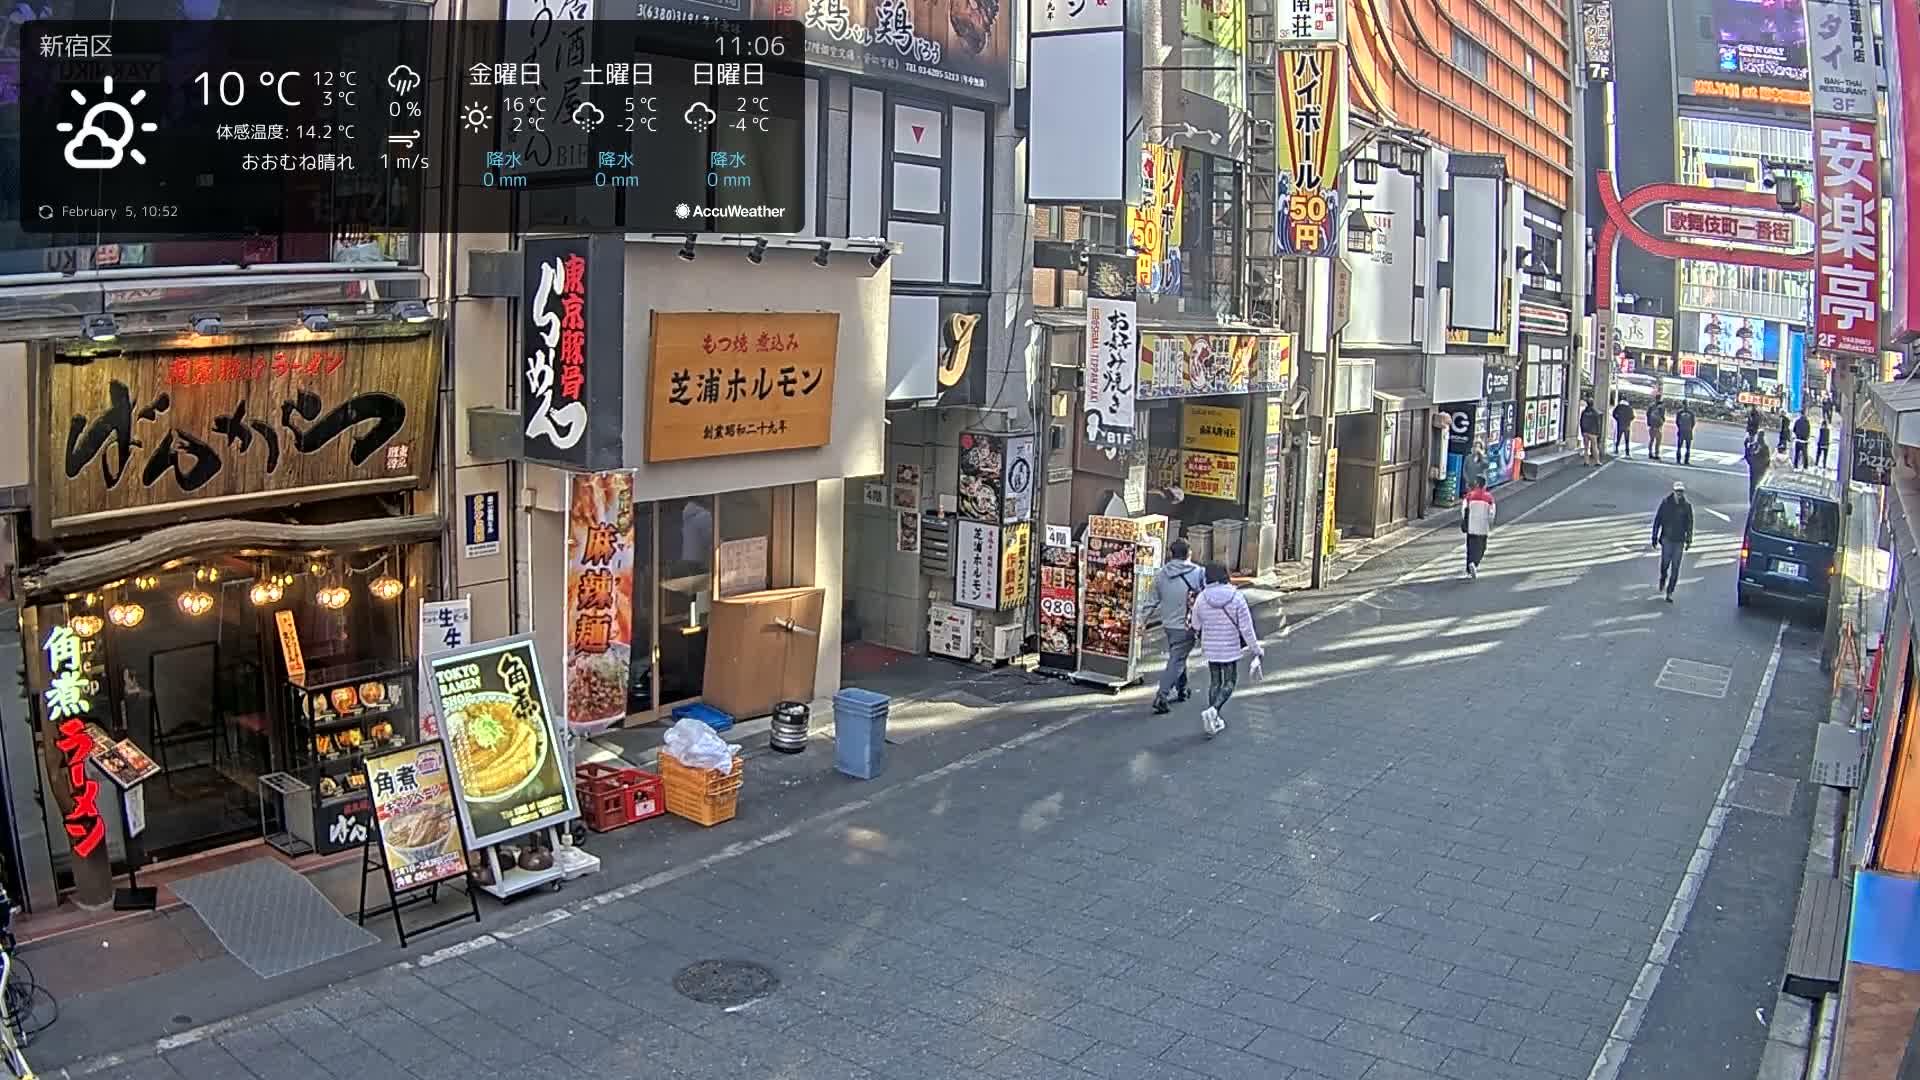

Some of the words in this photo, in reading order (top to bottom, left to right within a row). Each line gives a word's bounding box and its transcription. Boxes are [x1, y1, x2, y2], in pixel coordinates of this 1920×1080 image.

[1818, 13, 1843, 71] タイ
[1589, 64, 1609, 79] 7F
[1832, 97, 1856, 111] 3F
[1293, 52, 1322, 191] ハイボール
[1289, 195, 1327, 222] 50
[1133, 219, 1157, 251] 50
[1294, 225, 1321, 250] 円
[1669, 211, 1790, 242] 歌舞伎町一番街
[1820, 127, 1876, 330] 安楽亭
[561, 253, 586, 401] 東京豚骨
[702, 332, 749, 354] もつ焼
[755, 331, 800, 354] 煮込み
[1818, 332, 1837, 347] 2F
[1103, 311, 1132, 415] お好み焼き
[667, 366, 824, 406] 芝浦ホルモン
[65, 378, 408, 492] ばんから
[703, 420, 788, 441] 創業昭和二十九年
[1106, 431, 1133, 446] B1F
[1048, 531, 1067, 546] 4階
[1042, 598, 1074, 616] 980
[43, 625, 90, 721] 角煮
[435, 663, 480, 683] TOKYO
[439, 676, 482, 698] RAMEN
[500, 653, 541, 720] 角煮
[56, 718, 106, 858] ラーメン
[374, 765, 419, 797] 角煮
